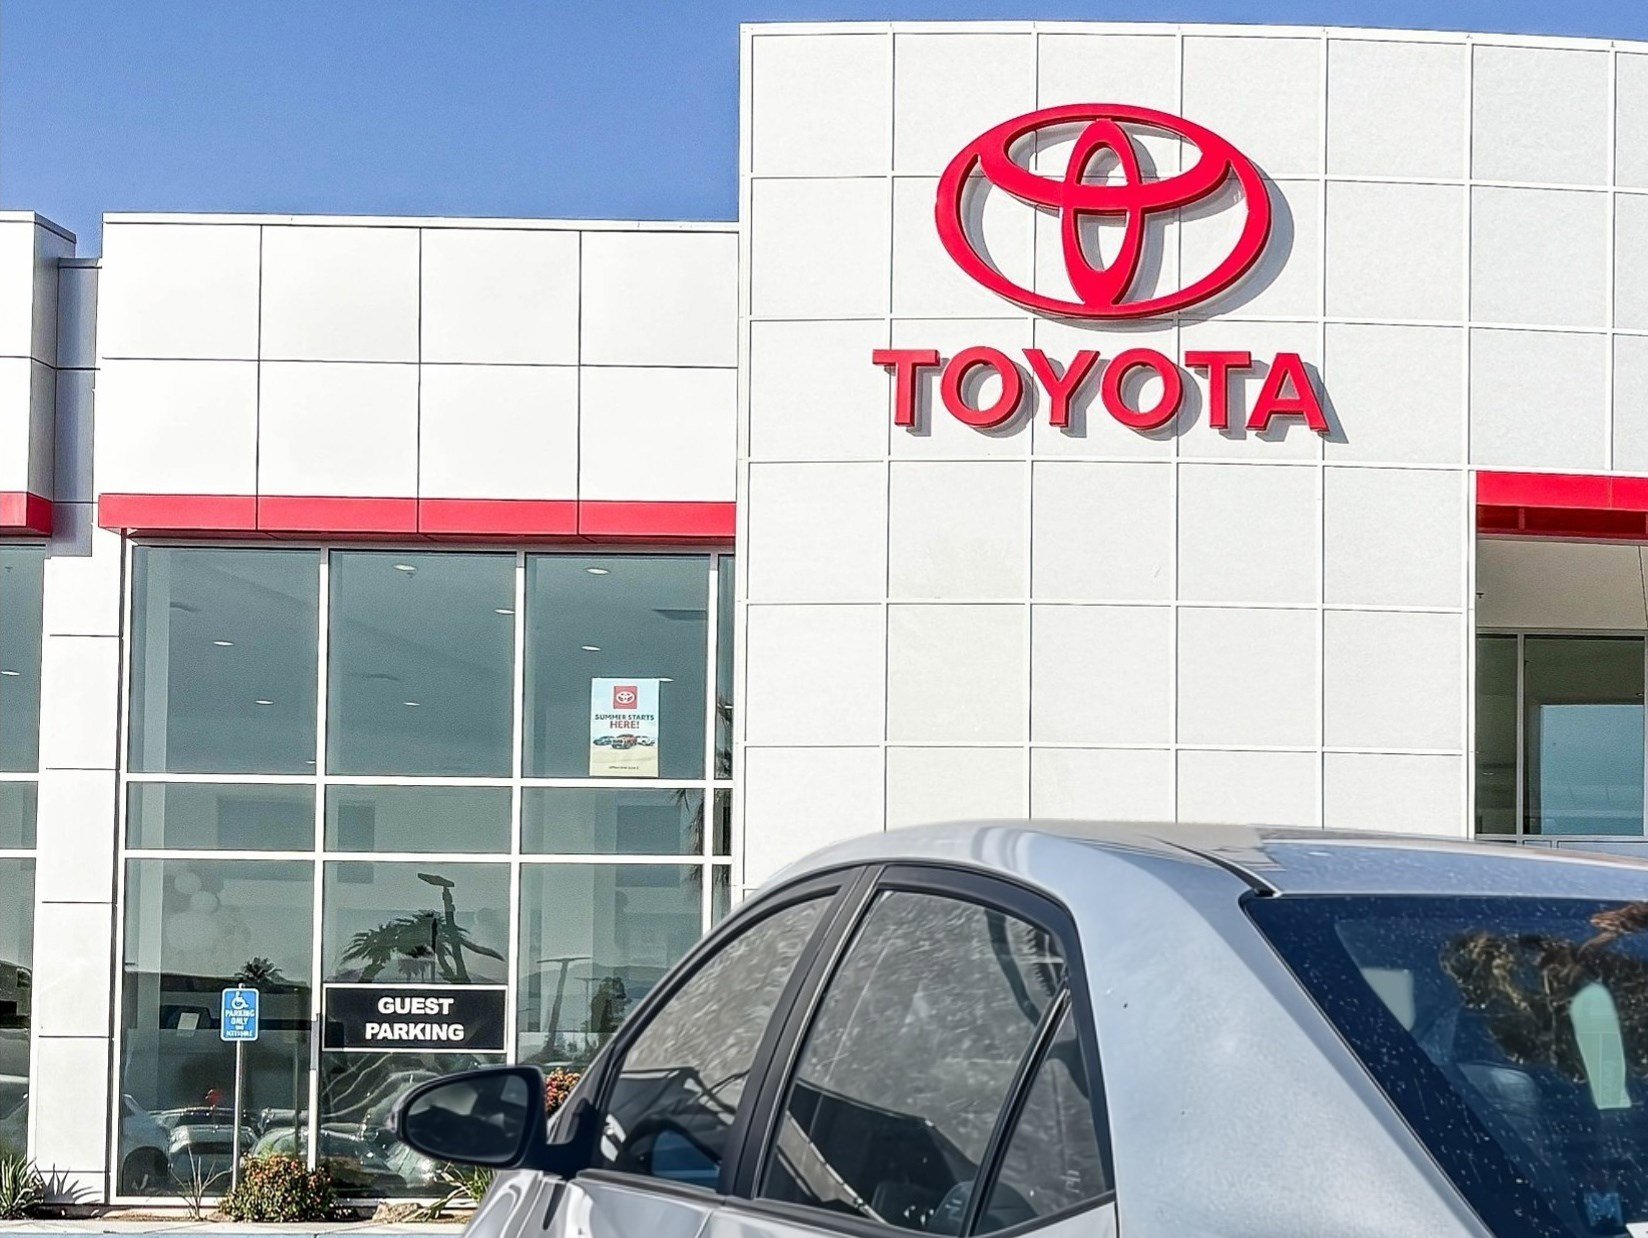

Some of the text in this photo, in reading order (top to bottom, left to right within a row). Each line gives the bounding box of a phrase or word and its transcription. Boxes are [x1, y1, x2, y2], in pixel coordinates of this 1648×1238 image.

[872, 346, 1329, 431] TOYOTA
[609, 720, 639, 729] HERE!
[377, 996, 455, 1015] GUEST
[225, 1009, 255, 1017] PARKING
[230, 1017, 249, 1025] ONLY
[365, 1022, 465, 1041] PARKING
